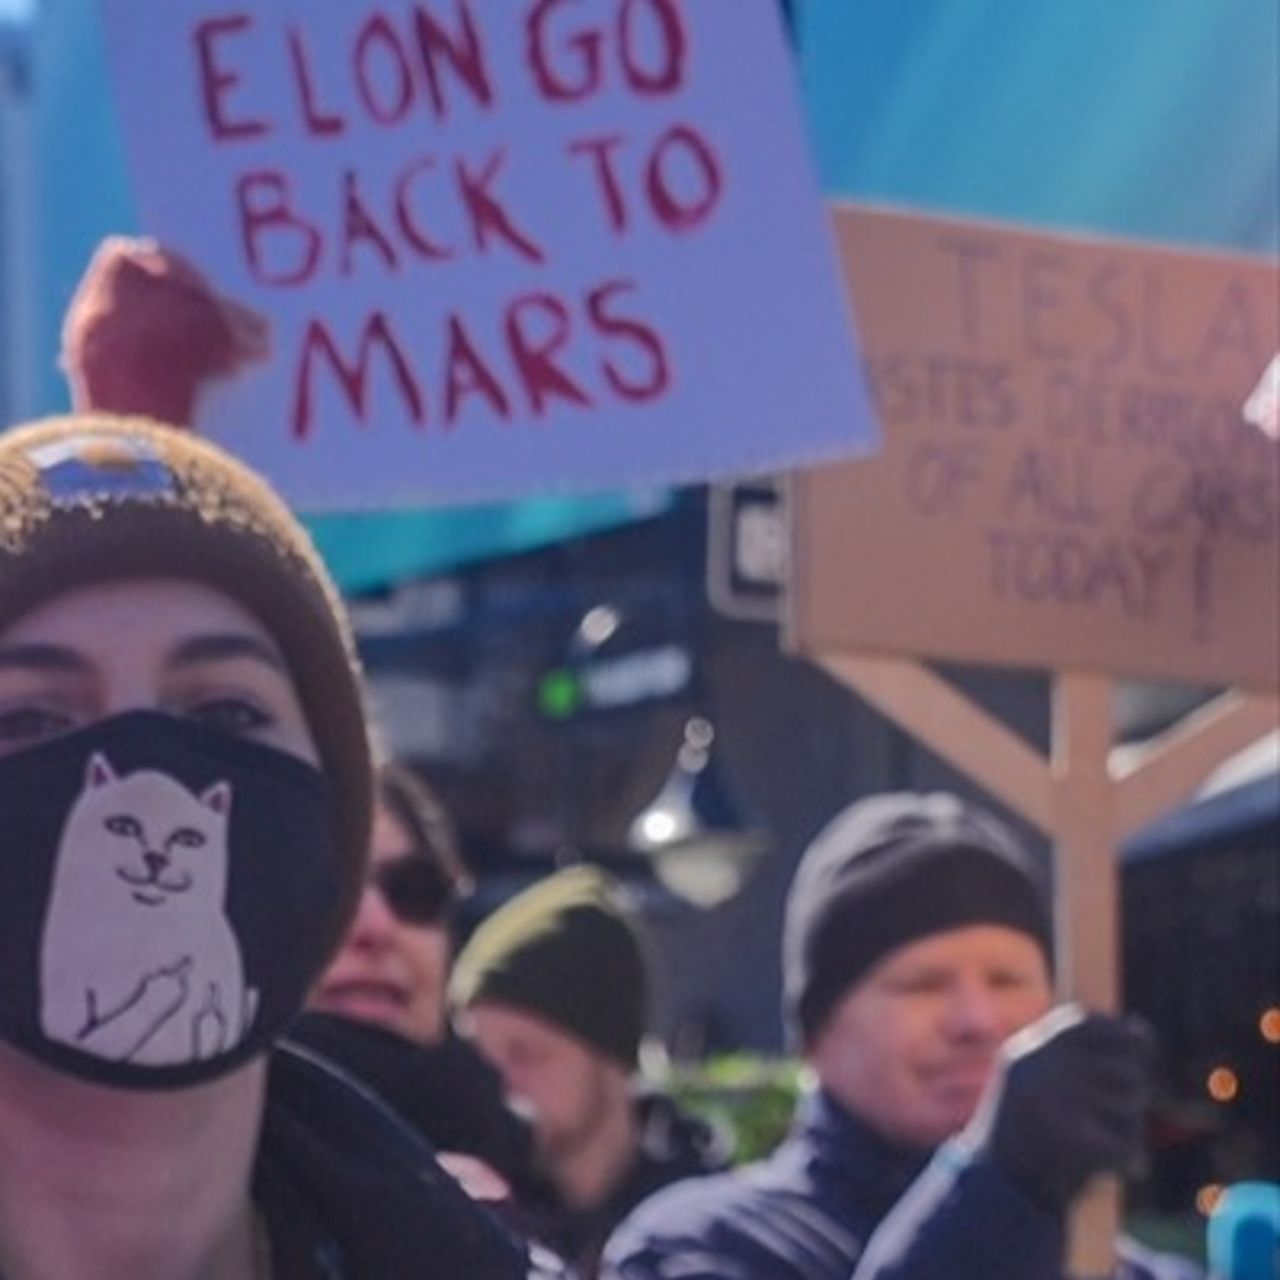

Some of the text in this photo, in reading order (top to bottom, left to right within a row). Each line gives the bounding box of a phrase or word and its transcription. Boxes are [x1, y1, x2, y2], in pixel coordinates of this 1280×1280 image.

[193, 0, 688, 143] ELON GO
[236, 123, 724, 290] BACK TO
[288, 280, 672, 442] MARS
[937, 232, 1265, 378] TESLA
[903, 440, 987, 520] OF
